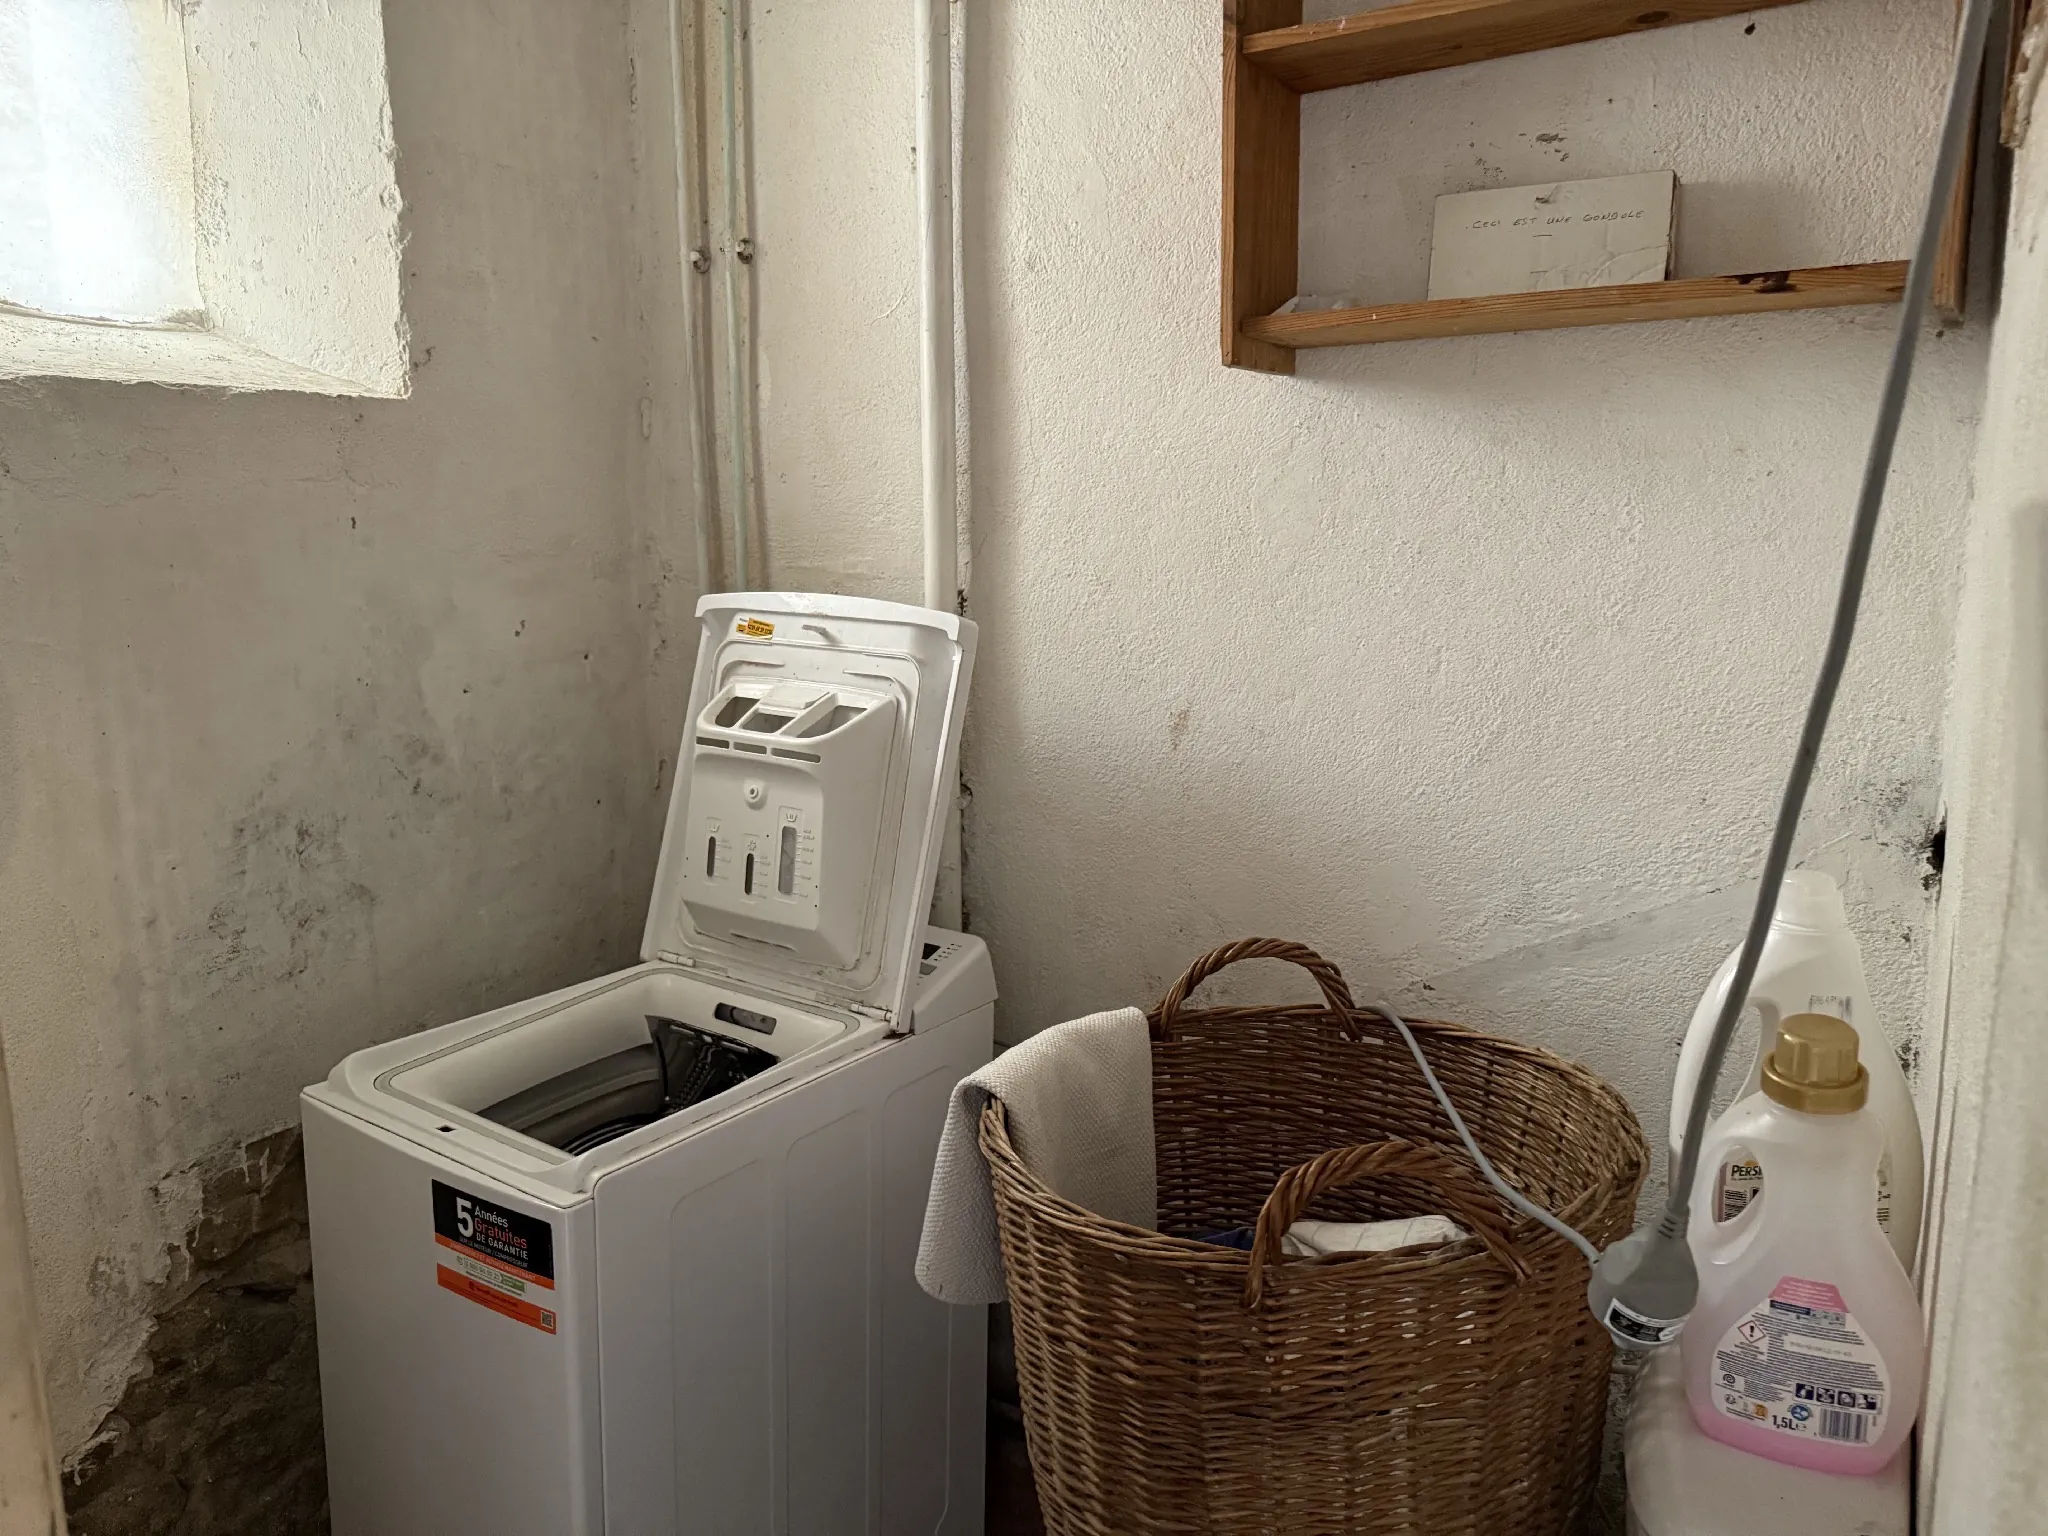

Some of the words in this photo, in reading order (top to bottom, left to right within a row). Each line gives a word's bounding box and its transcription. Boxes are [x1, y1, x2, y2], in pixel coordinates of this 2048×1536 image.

[1513, 217, 1538, 226] EST
[1546, 216, 1573, 225] UNE
[1731, 1164, 1763, 1177] PERSI
[456, 1196, 474, 1238] 5
[474, 1205, 509, 1228] Années
[474, 1217, 527, 1249] Gratuites
[476, 1232, 486, 1244] DE
[488, 1237, 529, 1260] GARANTIE
[1771, 1414, 1796, 1430] 1,5L
